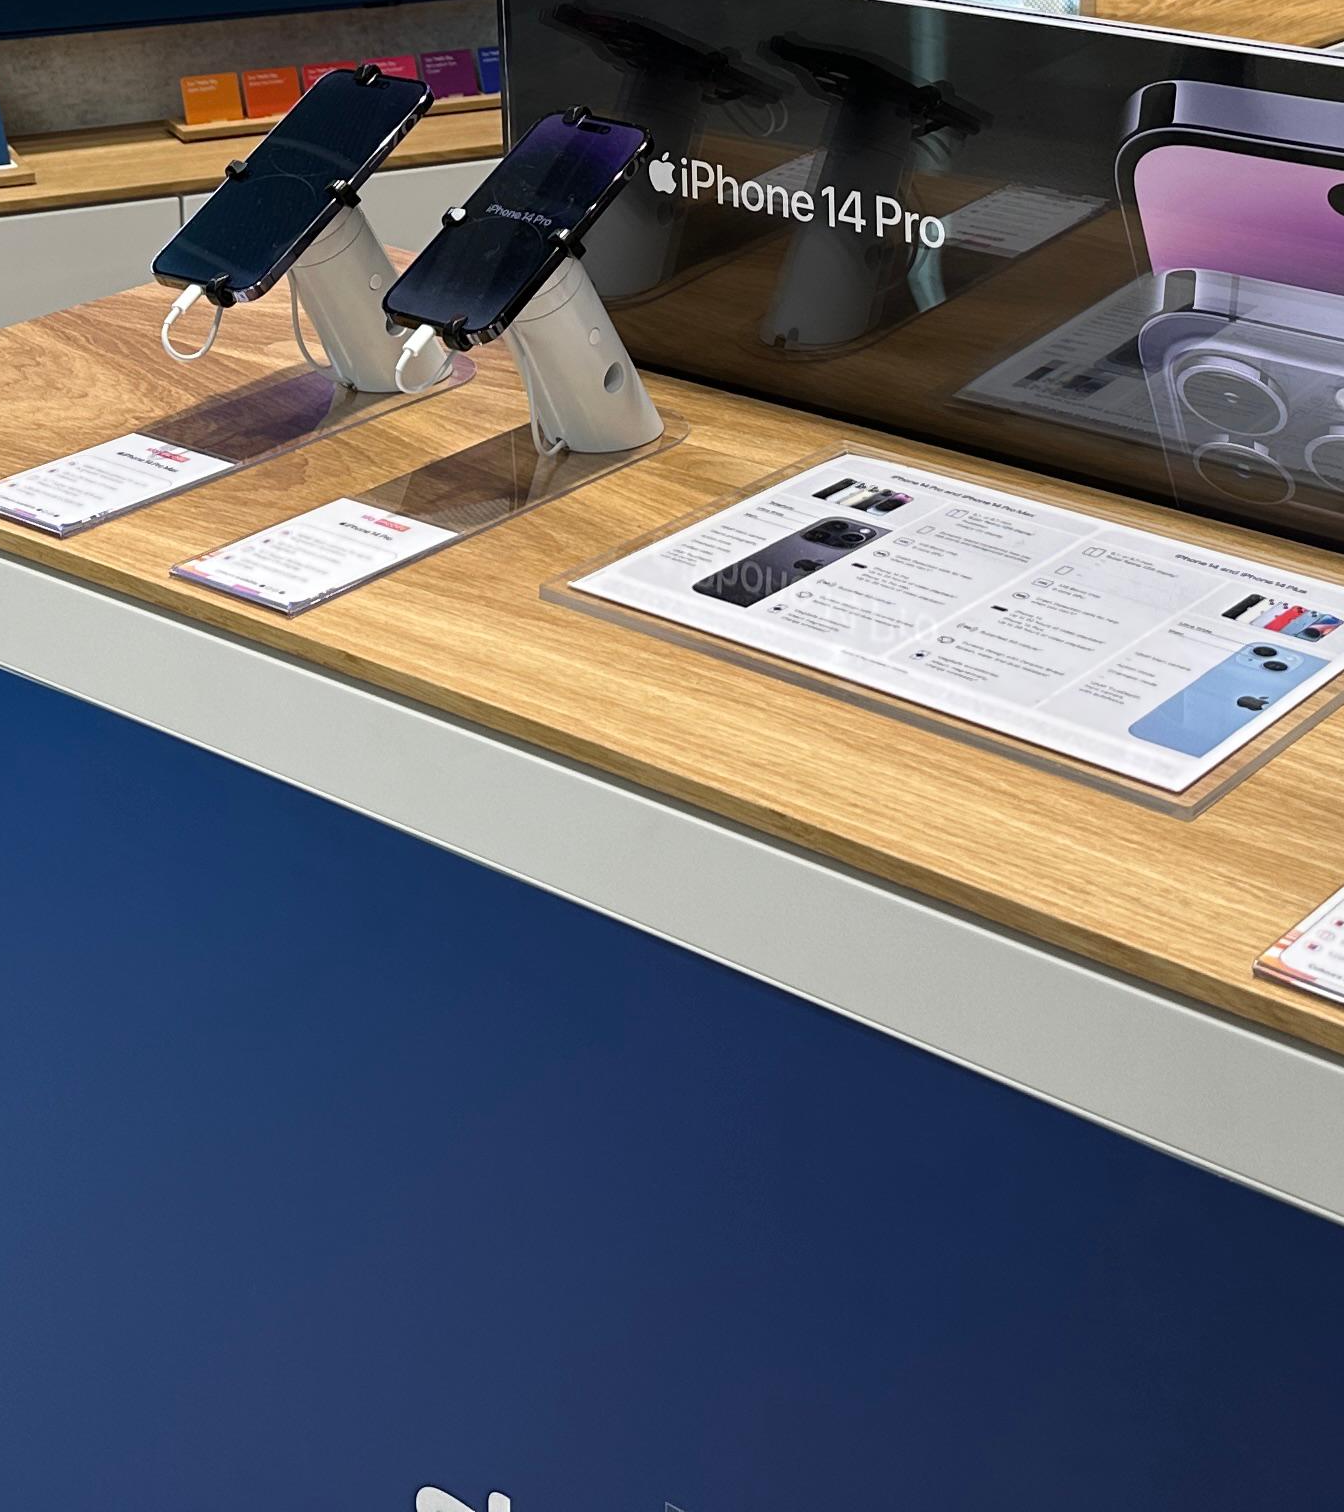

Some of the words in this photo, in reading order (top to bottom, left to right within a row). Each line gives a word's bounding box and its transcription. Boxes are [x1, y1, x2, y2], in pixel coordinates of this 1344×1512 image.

[485, 203, 522, 220] iPhone
[521, 211, 535, 223] 14
[533, 214, 553, 226] Pro
[680, 157, 815, 224] iPhone
[821, 185, 866, 233] 14
[875, 196, 946, 250] Pro
